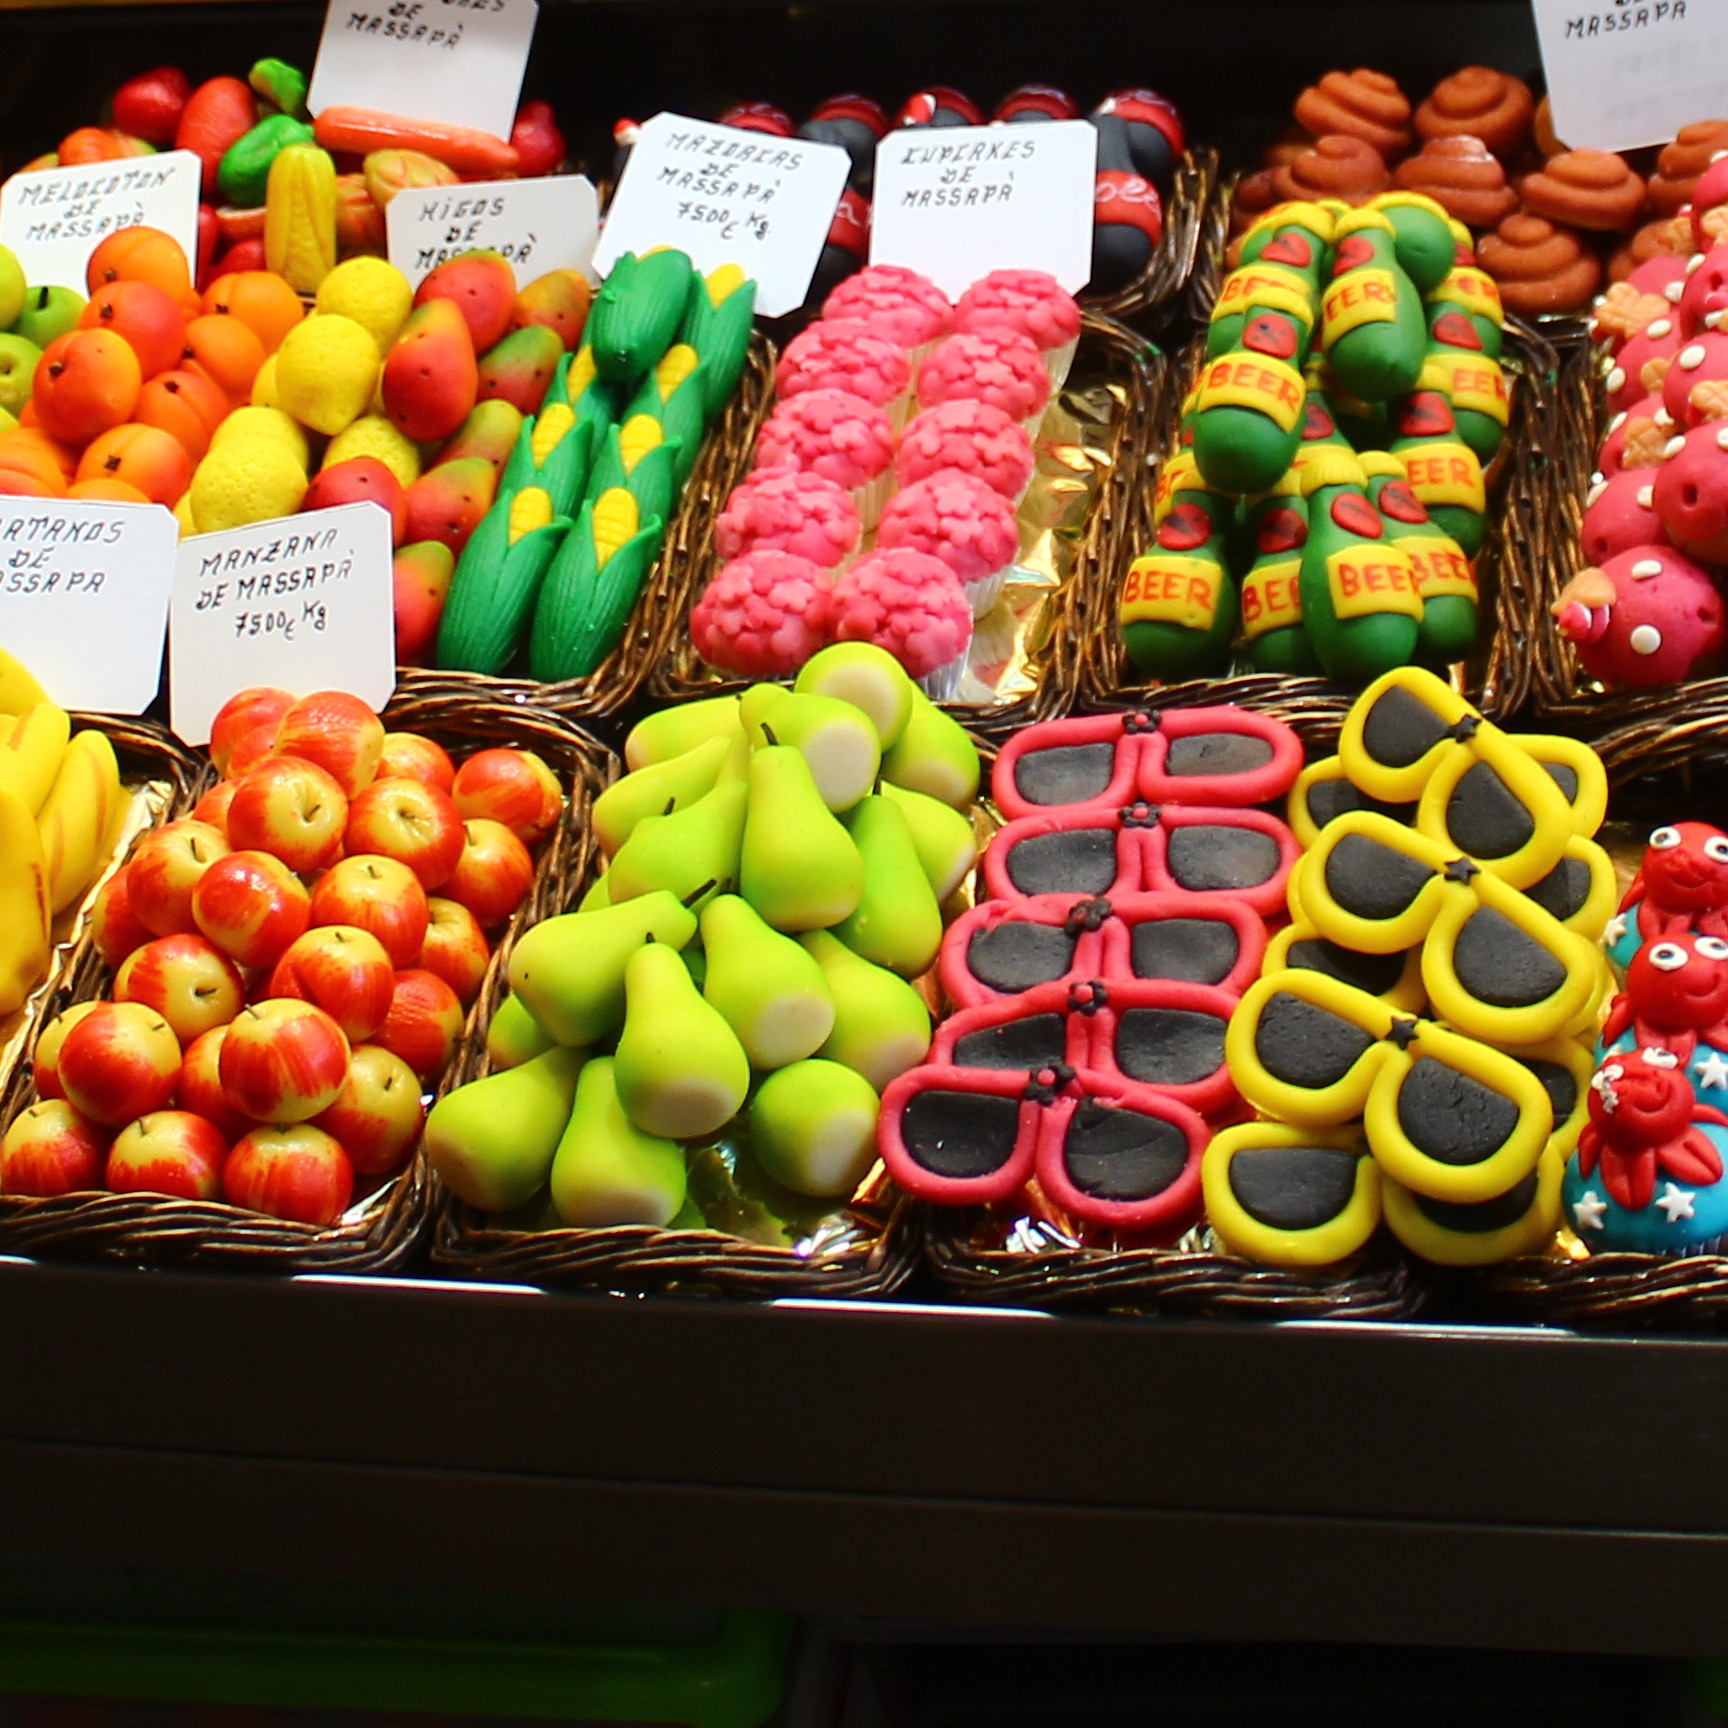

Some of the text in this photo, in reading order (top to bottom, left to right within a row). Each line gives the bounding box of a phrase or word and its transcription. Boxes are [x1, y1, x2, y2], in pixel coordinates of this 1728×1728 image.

[388, 1, 425, 20] DE
[346, 11, 464, 50] MASSAPÀ
[666, 133, 805, 172] MAZORCAS
[901, 140, 1037, 166] CUPCAKES
[656, 166, 782, 205] MASSAPÀ
[700, 162, 739, 180] DE
[939, 167, 976, 184] DE
[901, 170, 1016, 208] MASSAPÀ
[25, 202, 145, 241] MASSAPÀ
[61, 198, 102, 220] DE
[419, 196, 506, 222] HIGOS
[446, 221, 482, 243] DE
[1208, 362, 1302, 414] BEER
[8, 546, 56, 569] DE
[199, 527, 339, 578] MANZANA
[194, 548, 355, 611] DE MASSAPÀ
[1123, 570, 1214, 610] BEER
[301, 599, 327, 631] Kg
